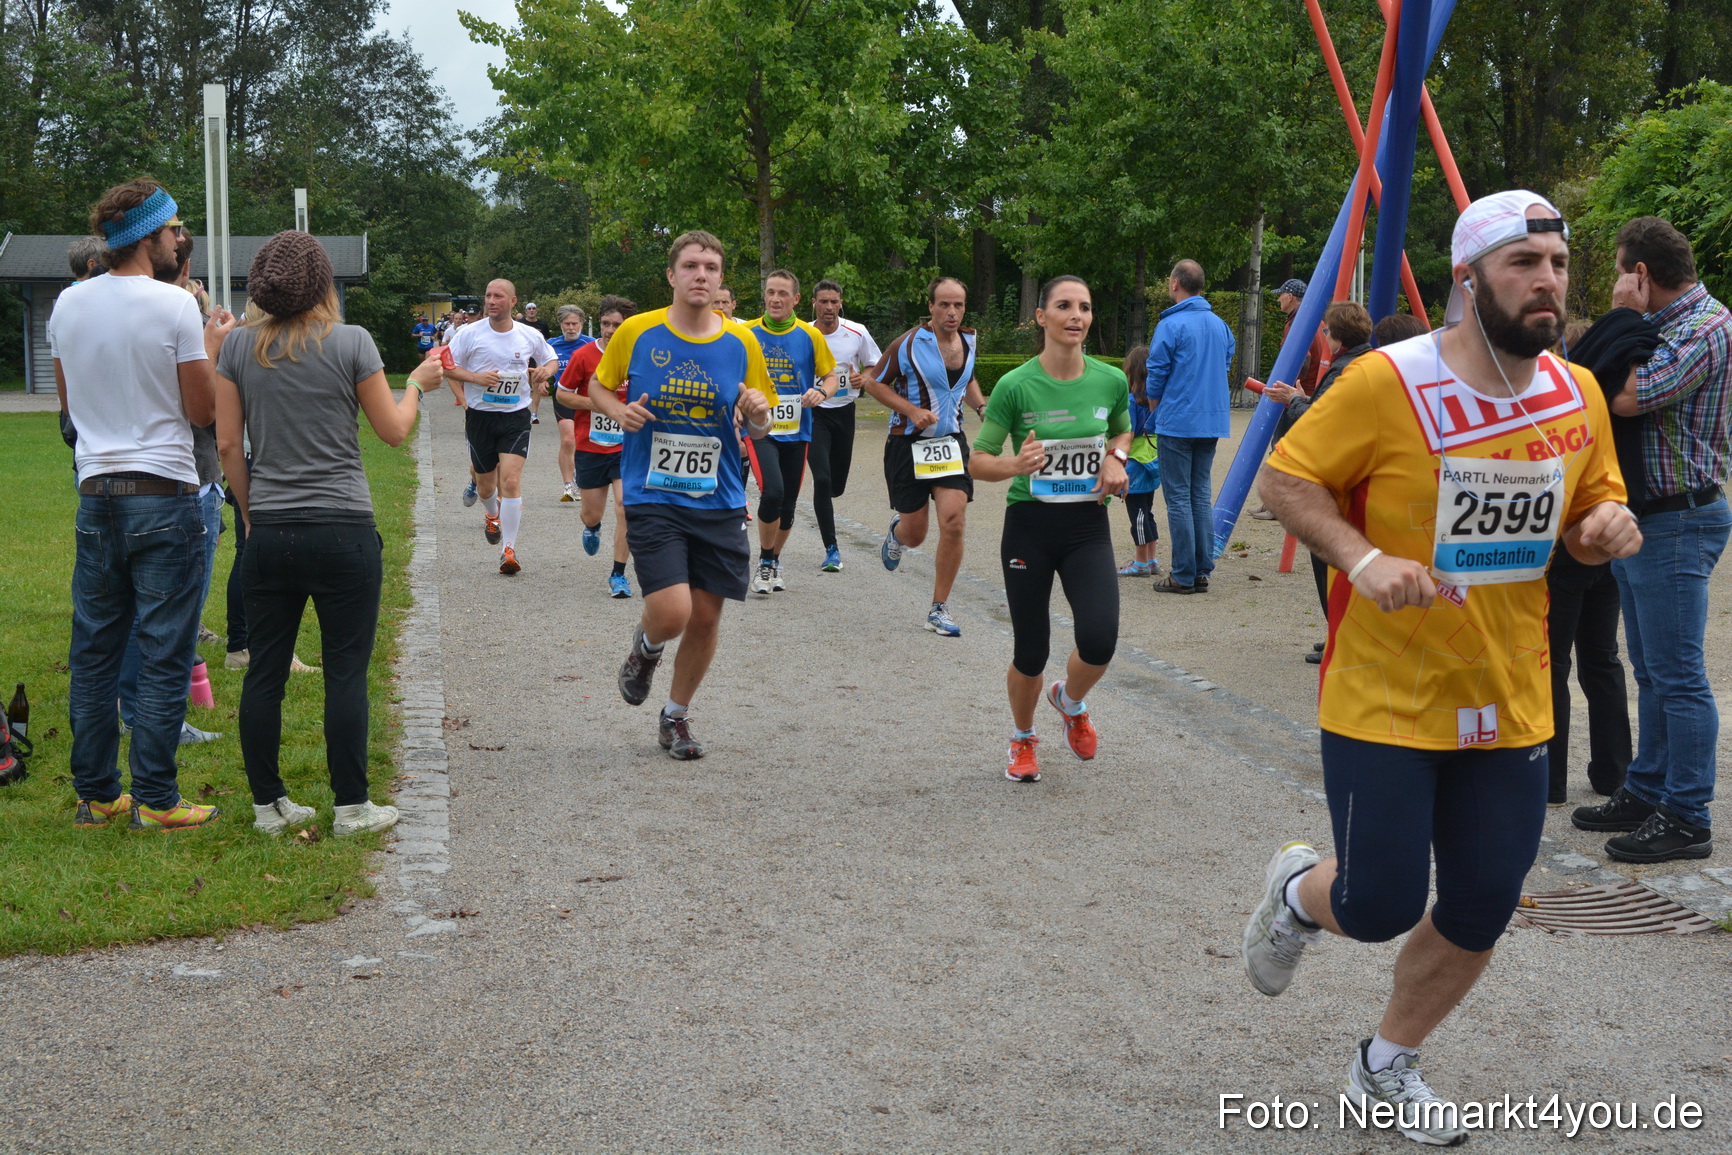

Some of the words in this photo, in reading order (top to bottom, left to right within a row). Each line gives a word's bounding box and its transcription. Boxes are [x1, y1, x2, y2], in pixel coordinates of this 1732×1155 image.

[594, 416, 625, 432] 334
[654, 436, 677, 447] PARTL
[678, 441, 710, 449] Neumarkt
[1060, 443, 1096, 451] Neumarkt
[657, 447, 713, 475] 2765
[922, 444, 952, 462] 250
[929, 465, 948, 473] Oliver
[1038, 451, 1101, 476] 2408
[663, 477, 702, 490] Clemens
[1443, 470, 1490, 484] PARTL
[1492, 473, 1550, 485] Neumarkt
[1450, 490, 1555, 536] 2599
[1455, 547, 1537, 568] Constantin
